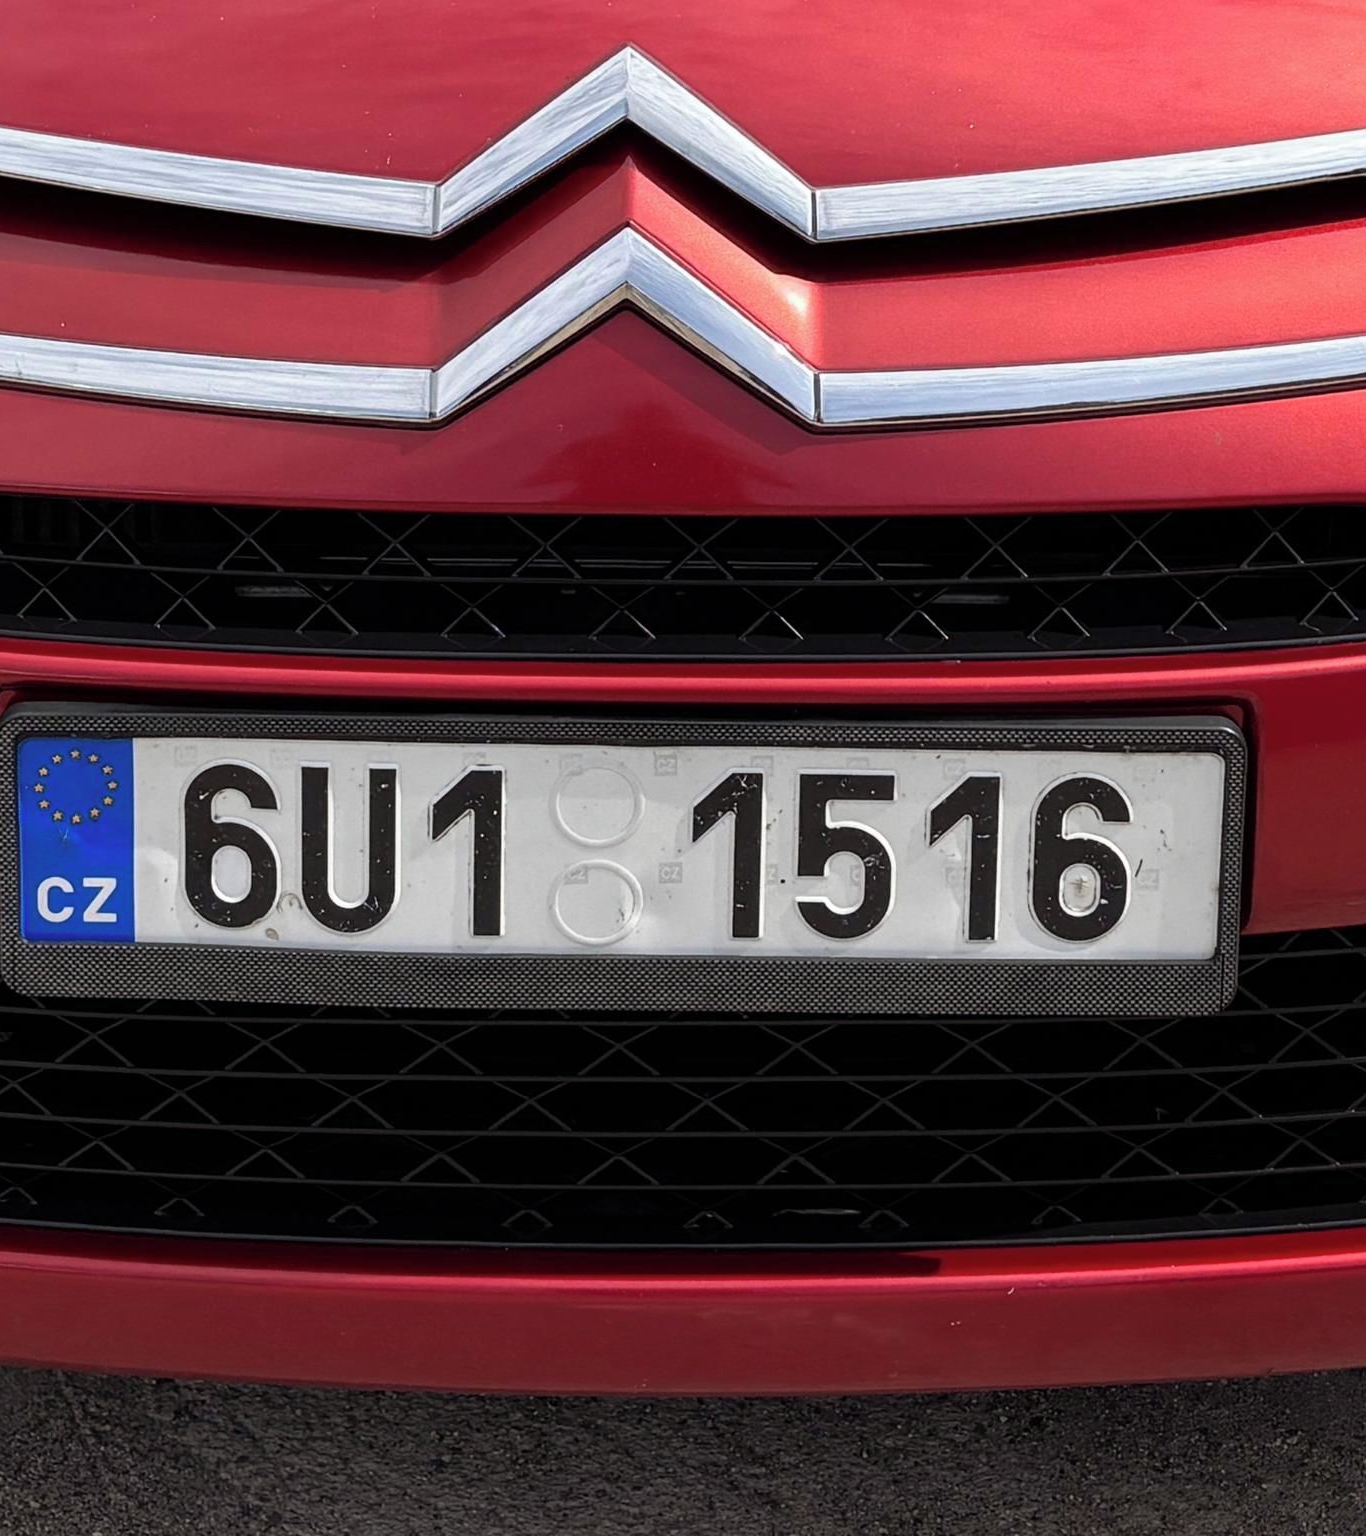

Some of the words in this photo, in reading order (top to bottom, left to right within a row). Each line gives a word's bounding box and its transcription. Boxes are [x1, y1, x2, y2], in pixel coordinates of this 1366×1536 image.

[37, 876, 117, 923] CZ
[183, 762, 504, 938] 6U1
[691, 771, 1133, 944] 1516
